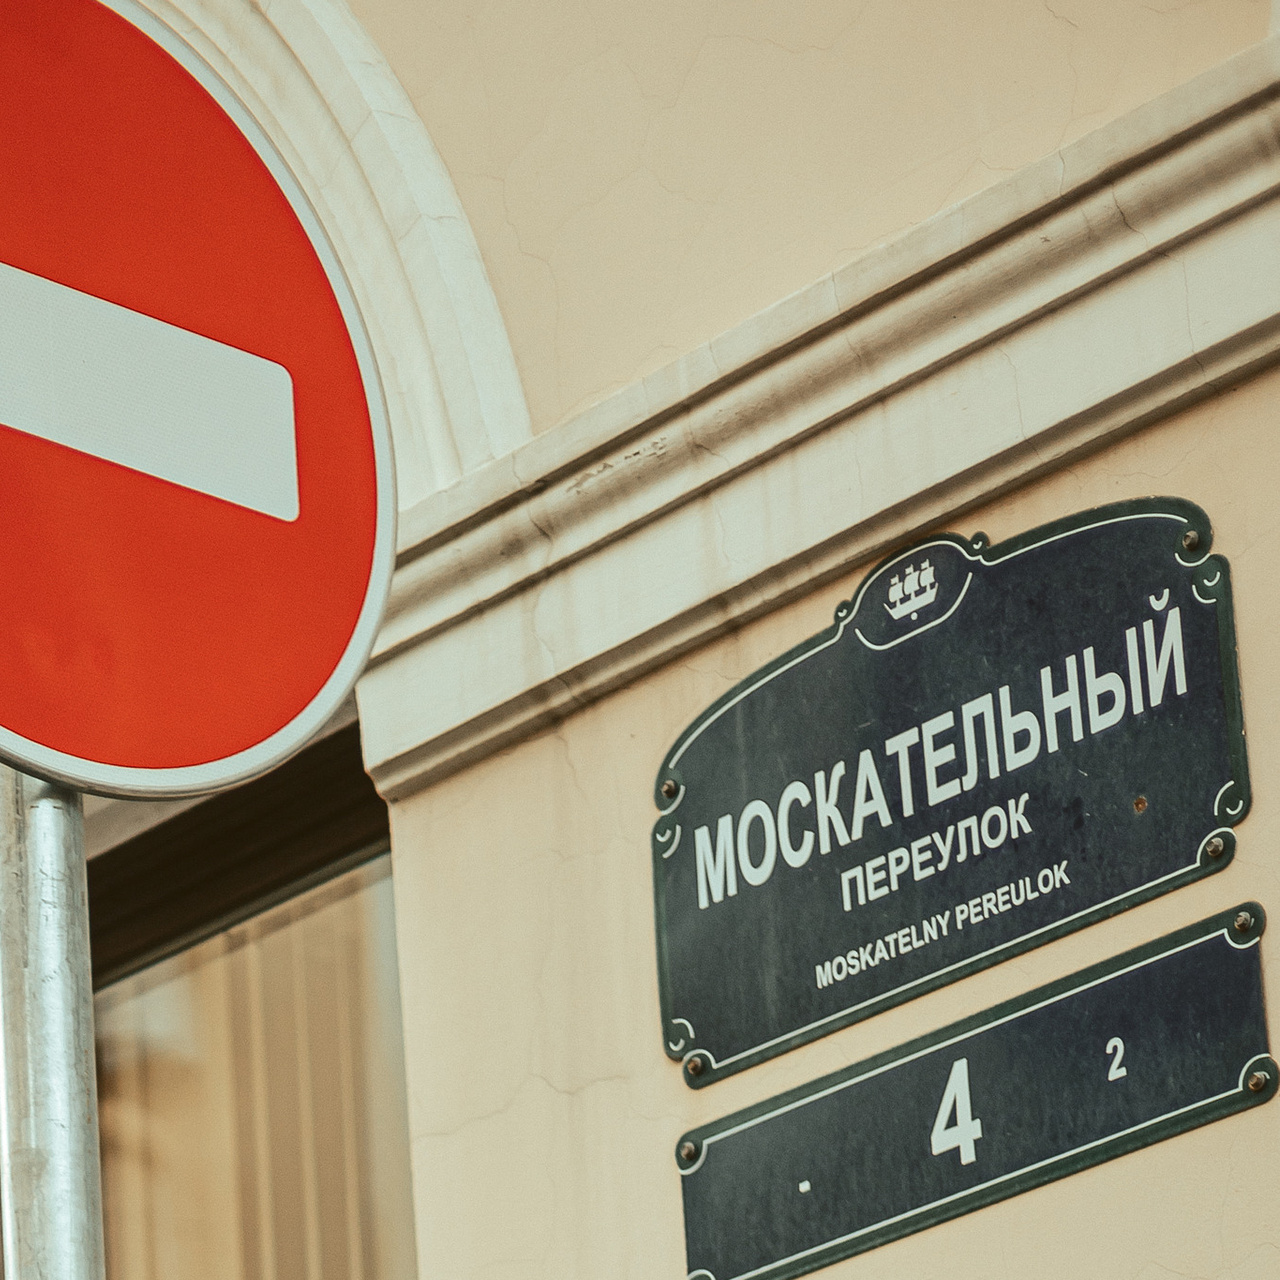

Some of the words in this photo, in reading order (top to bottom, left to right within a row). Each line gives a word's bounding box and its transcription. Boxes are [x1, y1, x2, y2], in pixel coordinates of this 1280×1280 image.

[693, 587, 1189, 911] МОСКАТЕЛЬНЫЙ
[840, 792, 1033, 912] ПЕРЕУЛОК
[815, 910, 951, 989] MOSKATELNY
[955, 860, 1071, 930] PEREULOK
[930, 1057, 983, 1166] 4
[1105, 1036, 1127, 1082] 2
